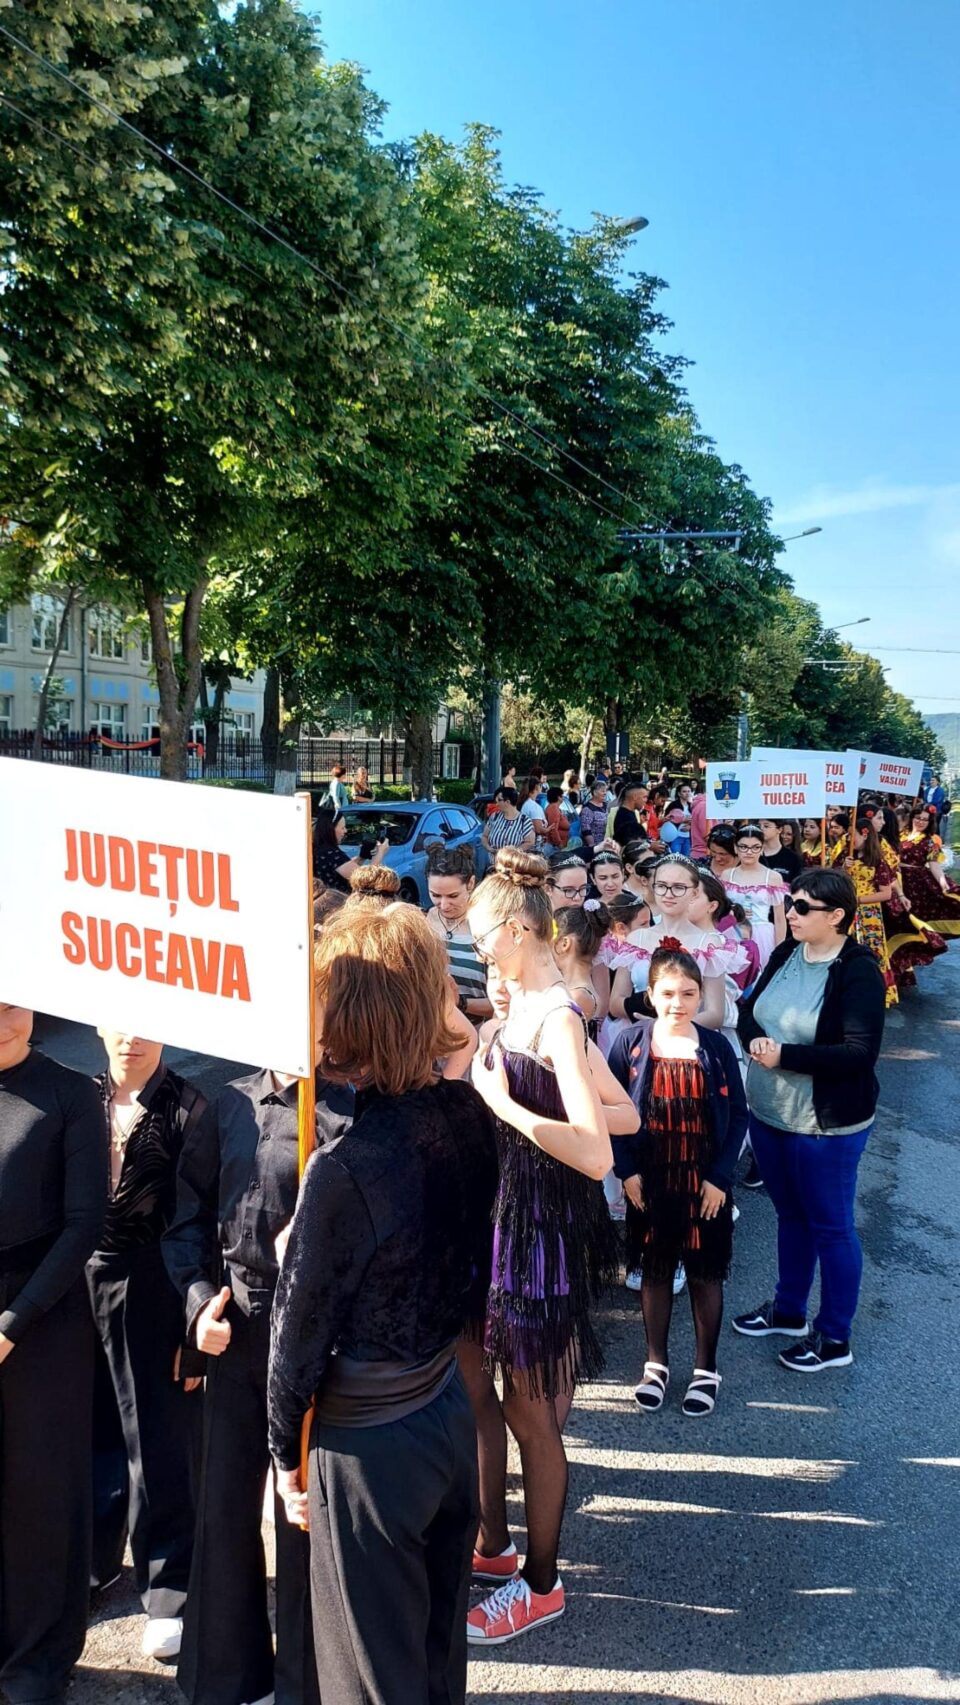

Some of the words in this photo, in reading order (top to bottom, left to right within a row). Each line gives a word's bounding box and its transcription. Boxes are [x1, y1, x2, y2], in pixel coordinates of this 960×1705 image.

[760, 773, 808, 789] JUDEȚUL
[880, 775, 907, 787] VASLUI
[763, 792, 806, 805] TULCEA
[64, 828, 239, 917] JUDEȚUL
[61, 911, 251, 1002] SUCEAVA
